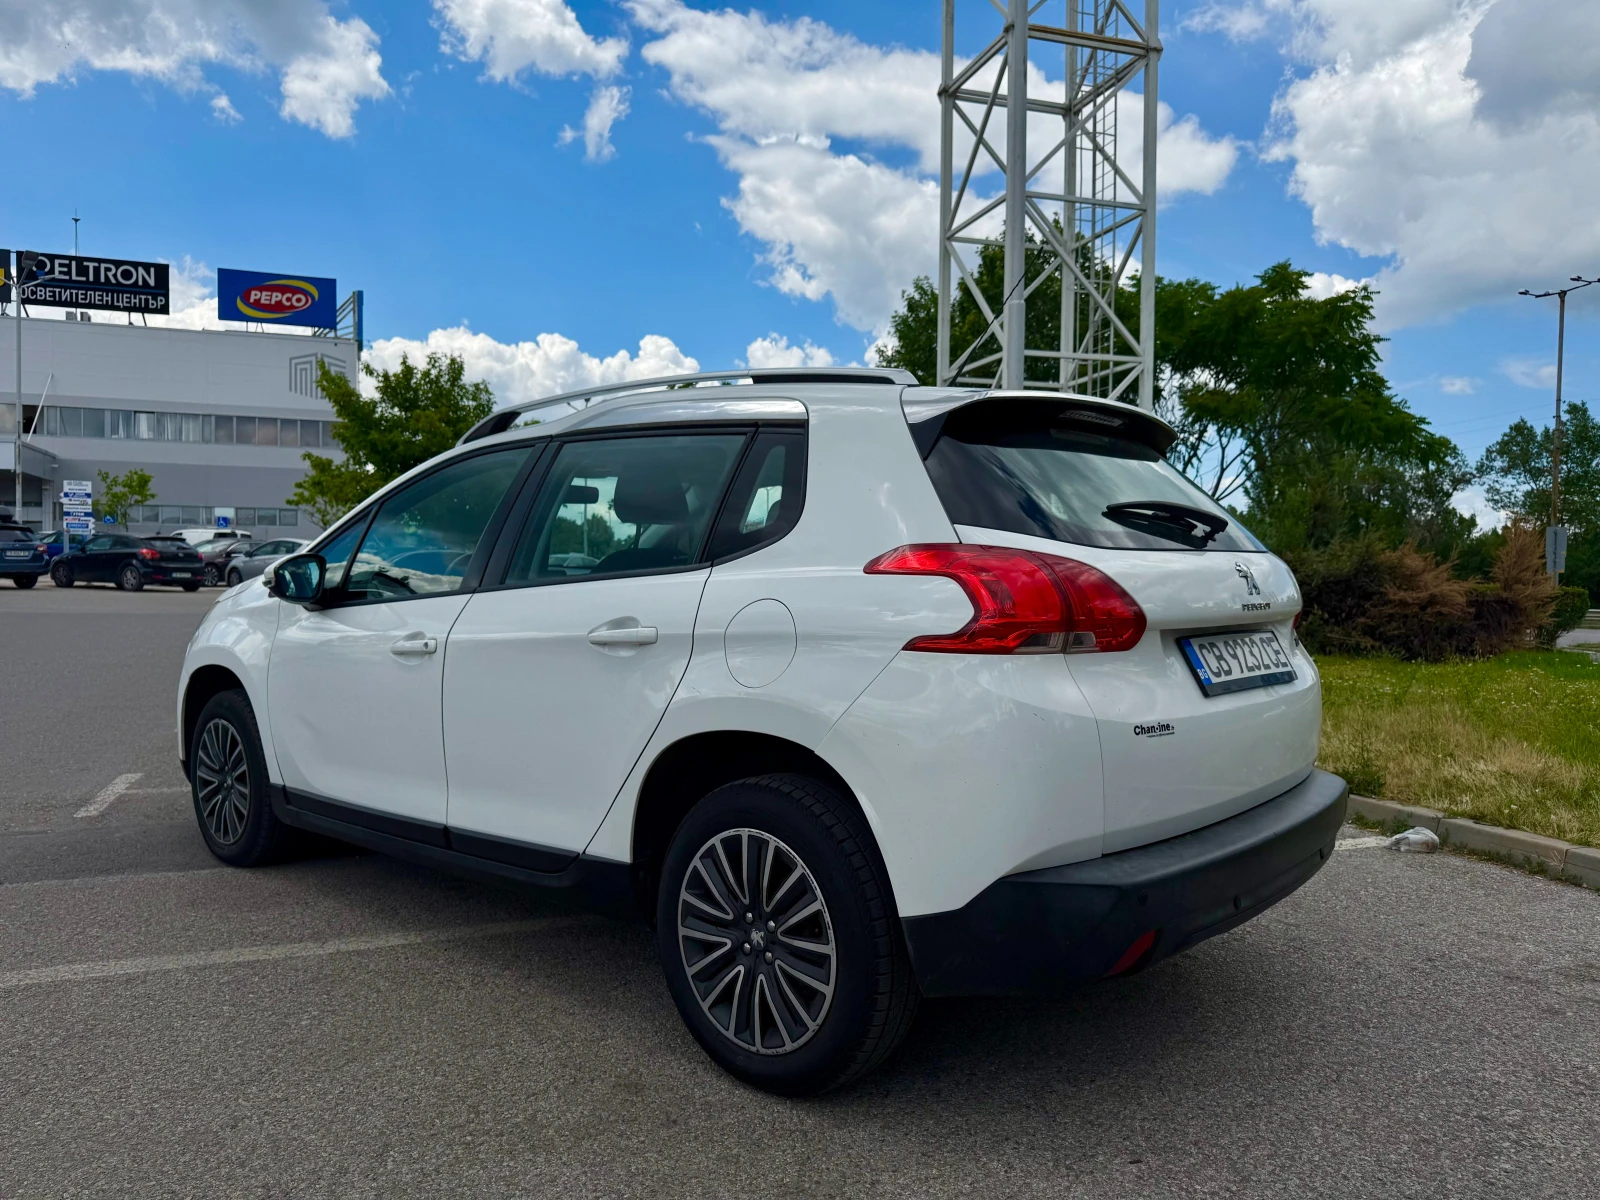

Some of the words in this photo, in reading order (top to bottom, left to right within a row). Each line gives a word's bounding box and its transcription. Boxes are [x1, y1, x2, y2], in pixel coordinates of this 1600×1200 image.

[20, 285, 112, 306] ОСВЕТИТЕЛЕН
[113, 292, 166, 310] ЦЕНТЪР
[249, 289, 307, 307] PEPCO
